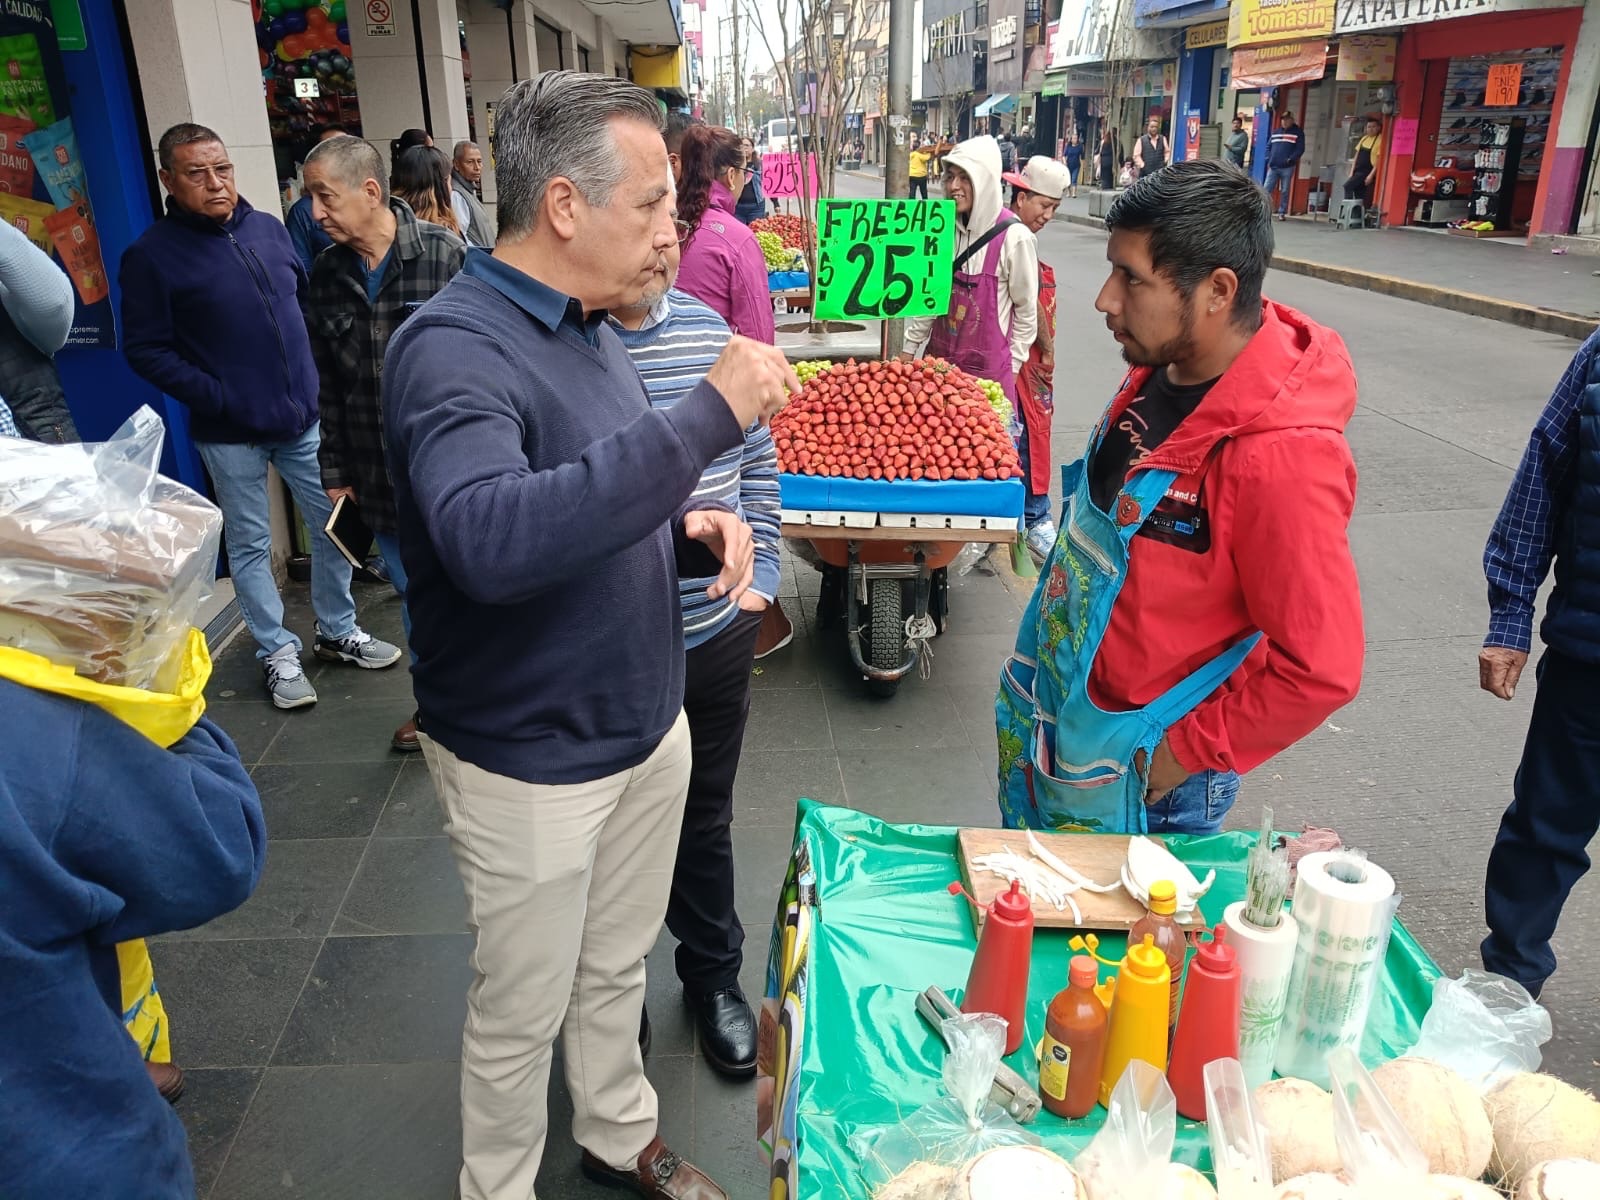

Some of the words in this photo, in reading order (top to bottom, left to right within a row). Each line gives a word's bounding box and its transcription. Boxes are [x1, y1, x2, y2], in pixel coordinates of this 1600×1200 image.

[6, 0, 42, 22] CALIDAD
[1248, 6, 1325, 36] Tomasin
[1341, 0, 1485, 27] ZAPATER
[1190, 25, 1227, 45] CELULARES
[0, 152, 28, 171] DANO
[764, 162, 798, 195] $25
[824, 200, 945, 241] FRESAS
[1174, 491, 1189, 500] and
